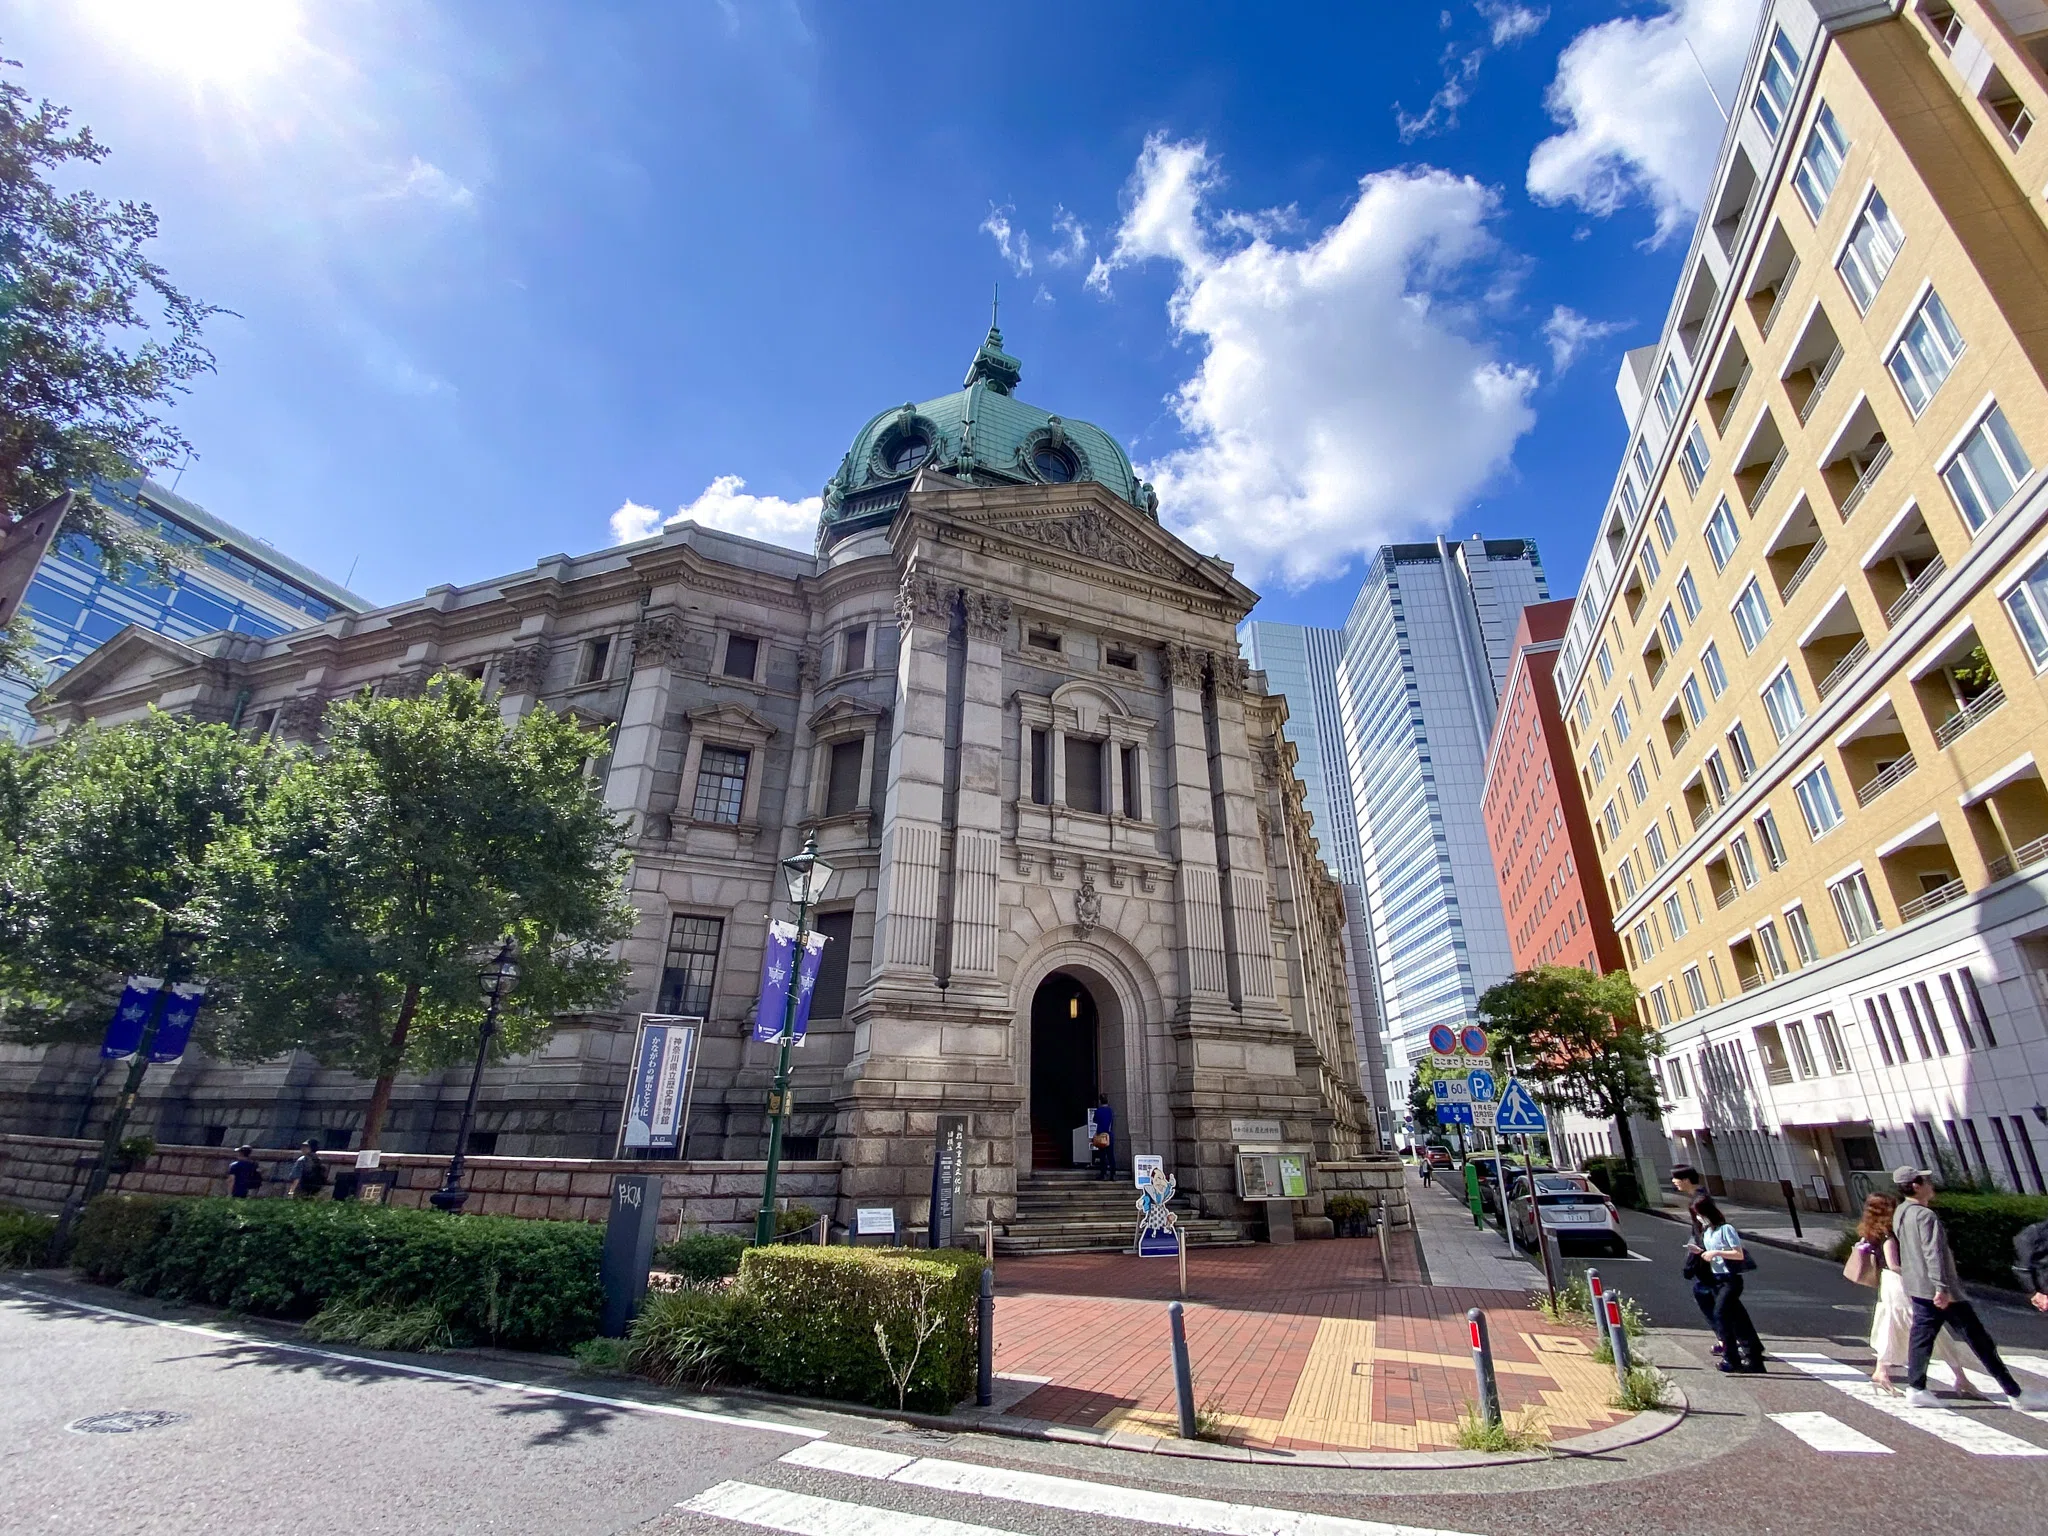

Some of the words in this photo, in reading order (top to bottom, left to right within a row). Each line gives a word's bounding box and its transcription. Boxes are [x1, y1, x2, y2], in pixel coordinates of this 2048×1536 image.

[1434, 1058, 1459, 1066] ここまで
[1465, 1058, 1491, 1067] ここから
[640, 1036, 661, 1117] かながわの歴史と文化
[660, 1037, 683, 1125] 神奈川県立歴史博物館
[1437, 1081, 1445, 1092] P
